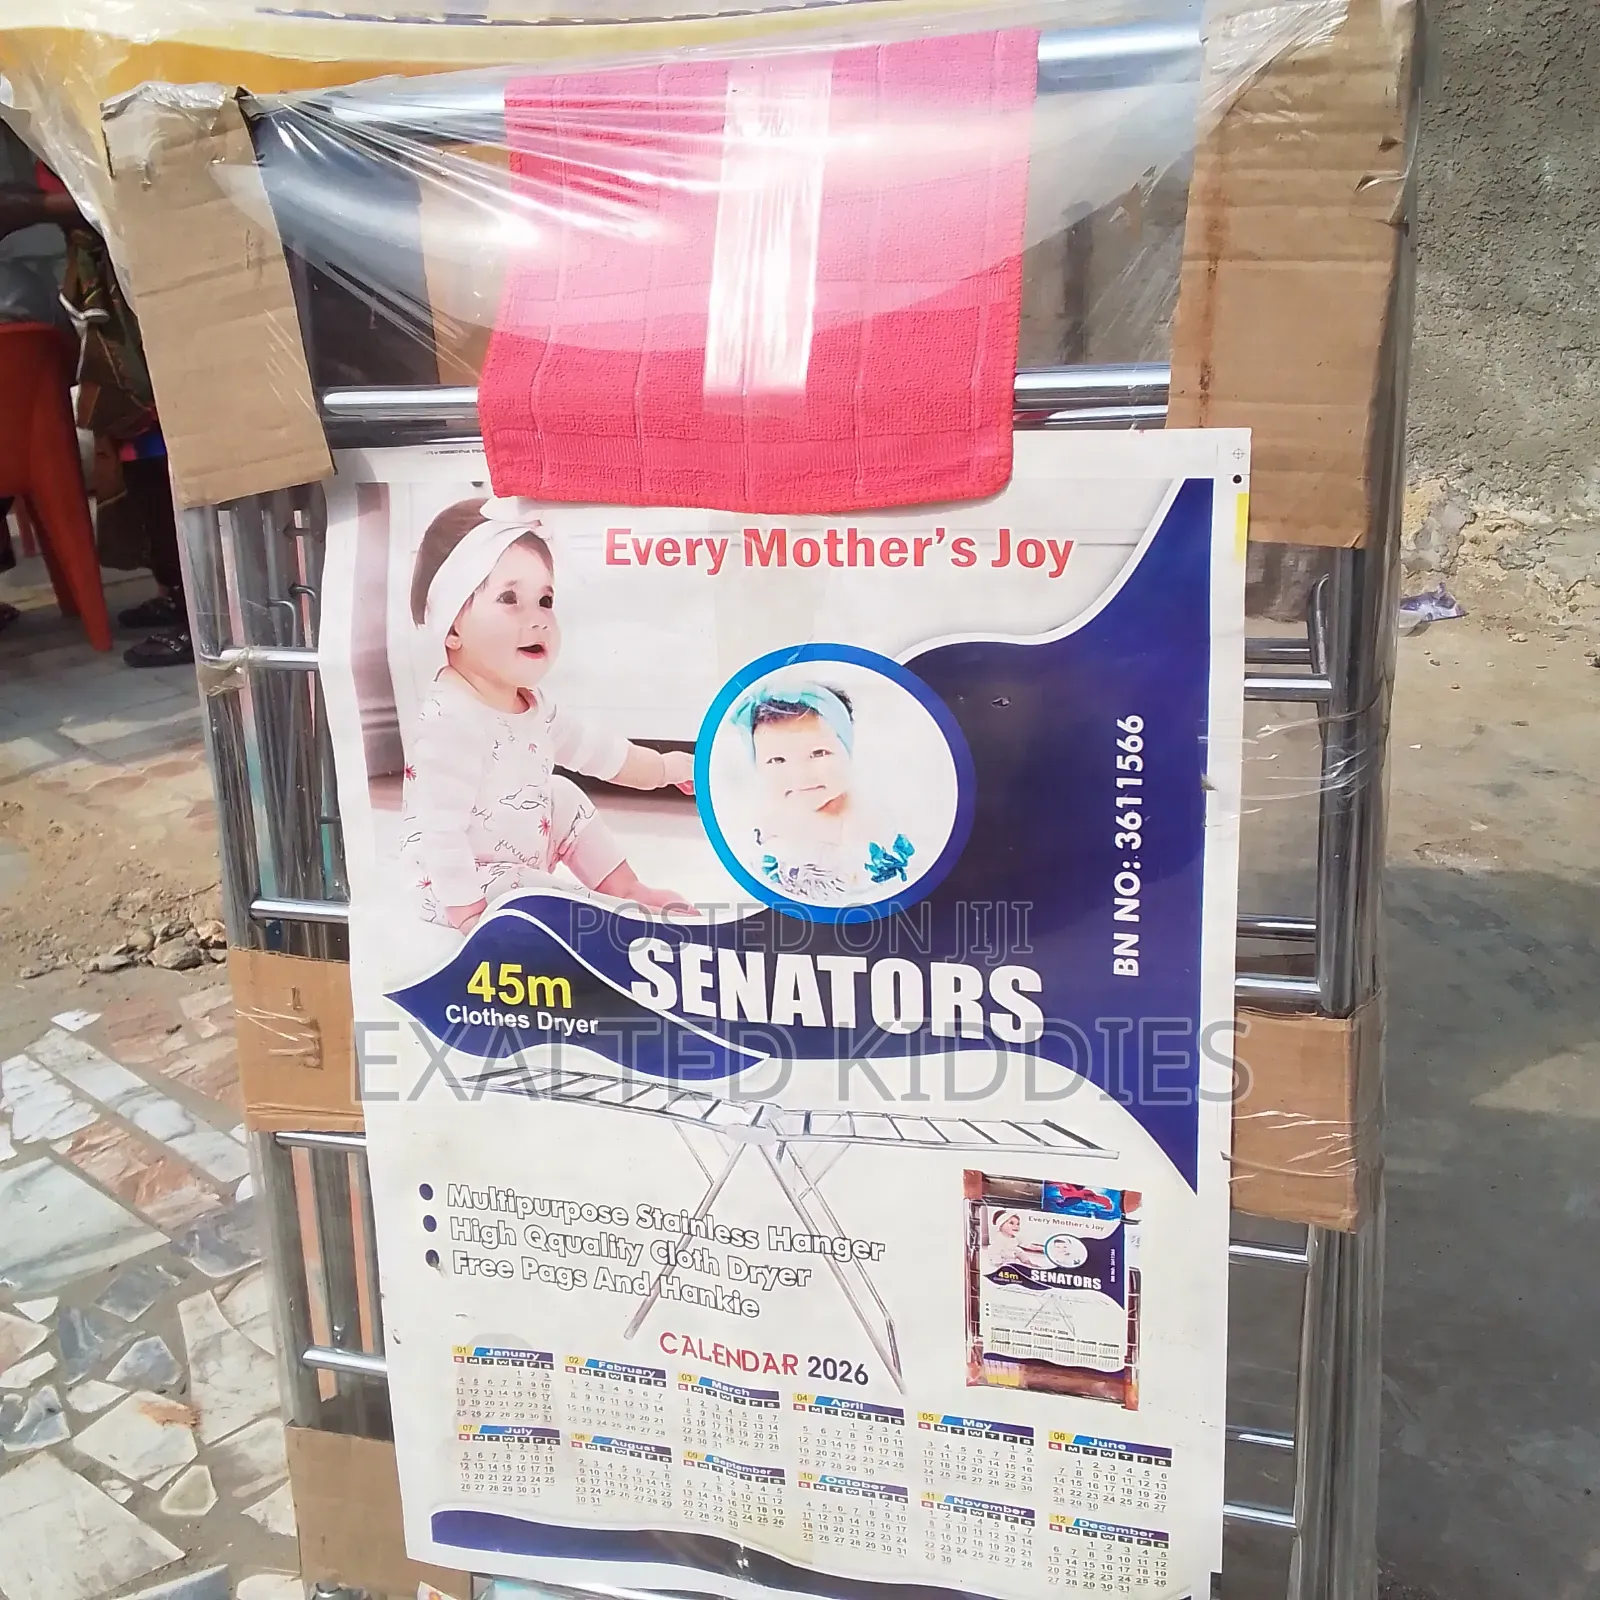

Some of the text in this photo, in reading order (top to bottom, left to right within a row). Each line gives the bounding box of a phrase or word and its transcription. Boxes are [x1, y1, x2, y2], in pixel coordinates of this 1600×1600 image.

[605, 527, 1075, 578] Every Mother’s Joy
[1112, 714, 1145, 977] BN NO: 3611566
[466, 961, 573, 1008] 45m
[628, 937, 1044, 1044] SENATORS
[445, 1005, 599, 1037] Clothes Dryer
[446, 1183, 886, 1262] Multipurpose Stainless Hanger
[450, 1217, 812, 1291] High Qquality Cloth Dryer
[452, 1250, 760, 1319] Free Pags And Hankie
[1030, 1269, 1102, 1290] SENATORS
[486, 1348, 540, 1360] January
[659, 1332, 868, 1386] CALENDAR 2026
[598, 1361, 655, 1377] February
[681, 1373, 750, 1397] 03 March
[831, 1399, 864, 1410] April
[504, 1427, 533, 1436] July
[922, 1413, 992, 1430] 05 May
[610, 1439, 656, 1452] August
[1053, 1432, 1126, 1450] 06 June
[713, 1456, 772, 1475] September
[825, 1476, 886, 1490] October
[927, 1492, 1027, 1515] 11 November
[1055, 1515, 1154, 1538] 12 December
